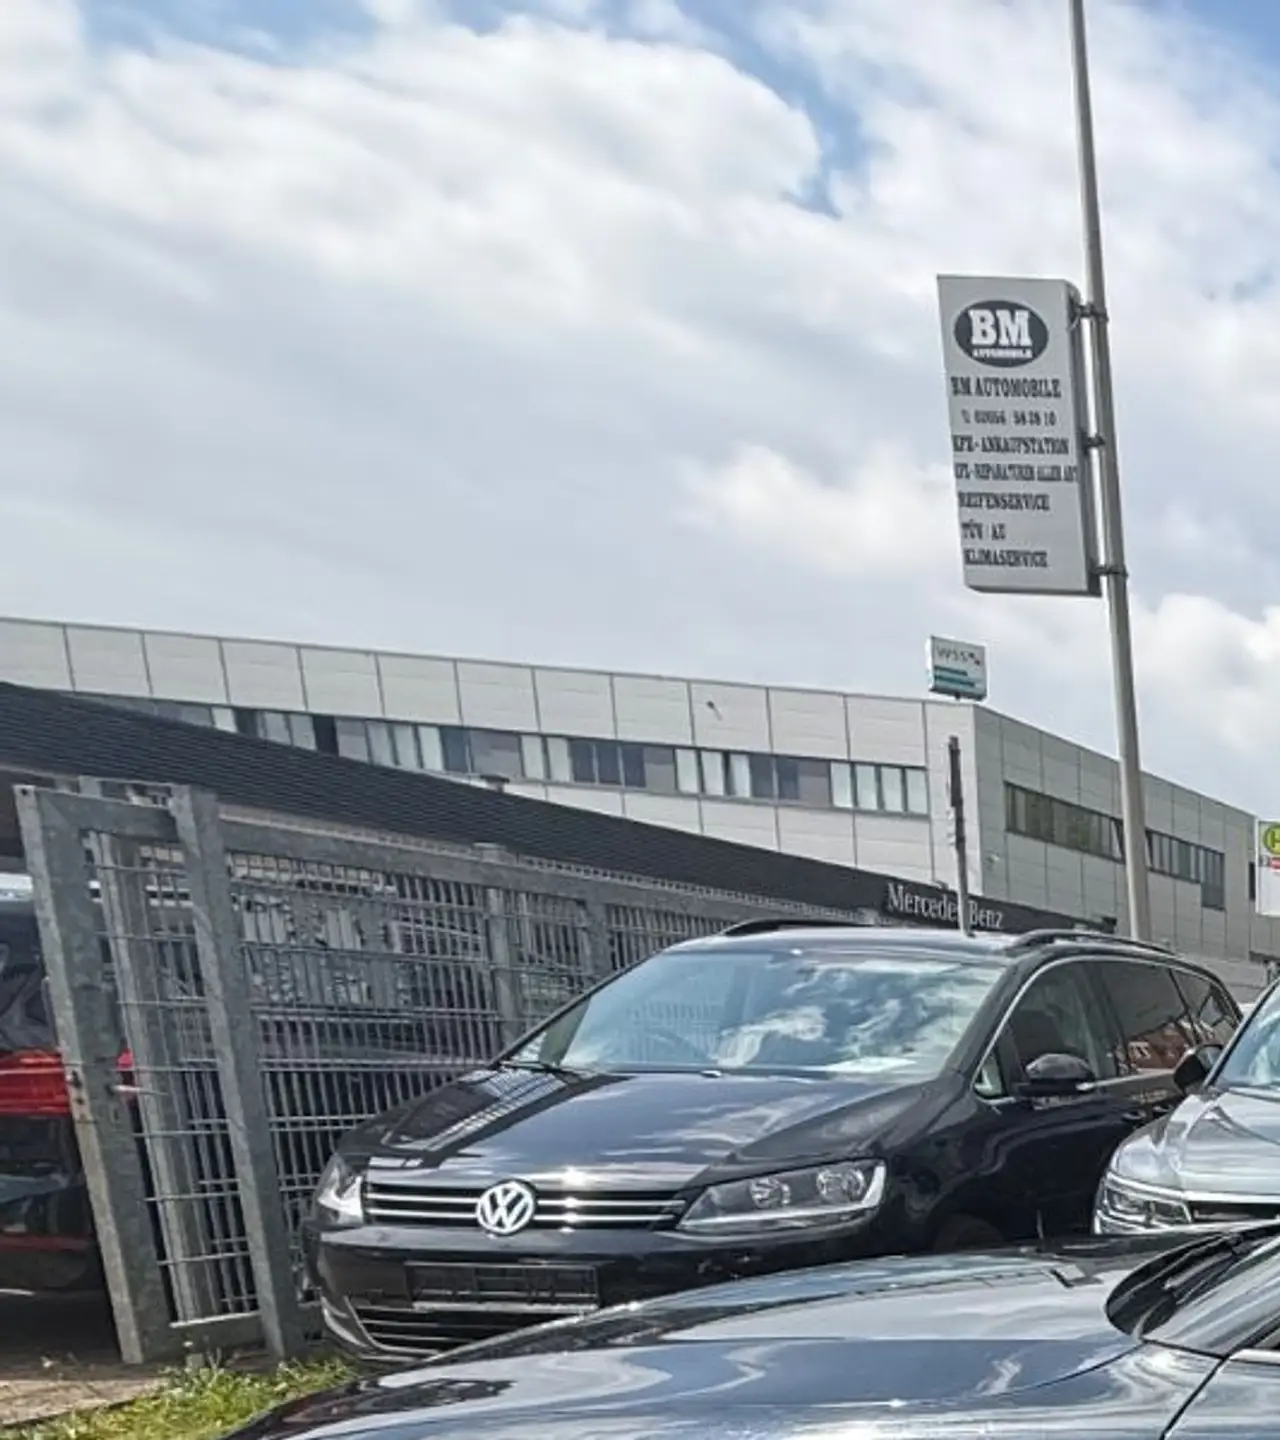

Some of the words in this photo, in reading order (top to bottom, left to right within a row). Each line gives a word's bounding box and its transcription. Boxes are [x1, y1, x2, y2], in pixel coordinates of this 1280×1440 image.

[968, 308, 1033, 347] BM
[950, 376, 971, 397] BM
[975, 377, 1062, 399] AUTOMOBILE
